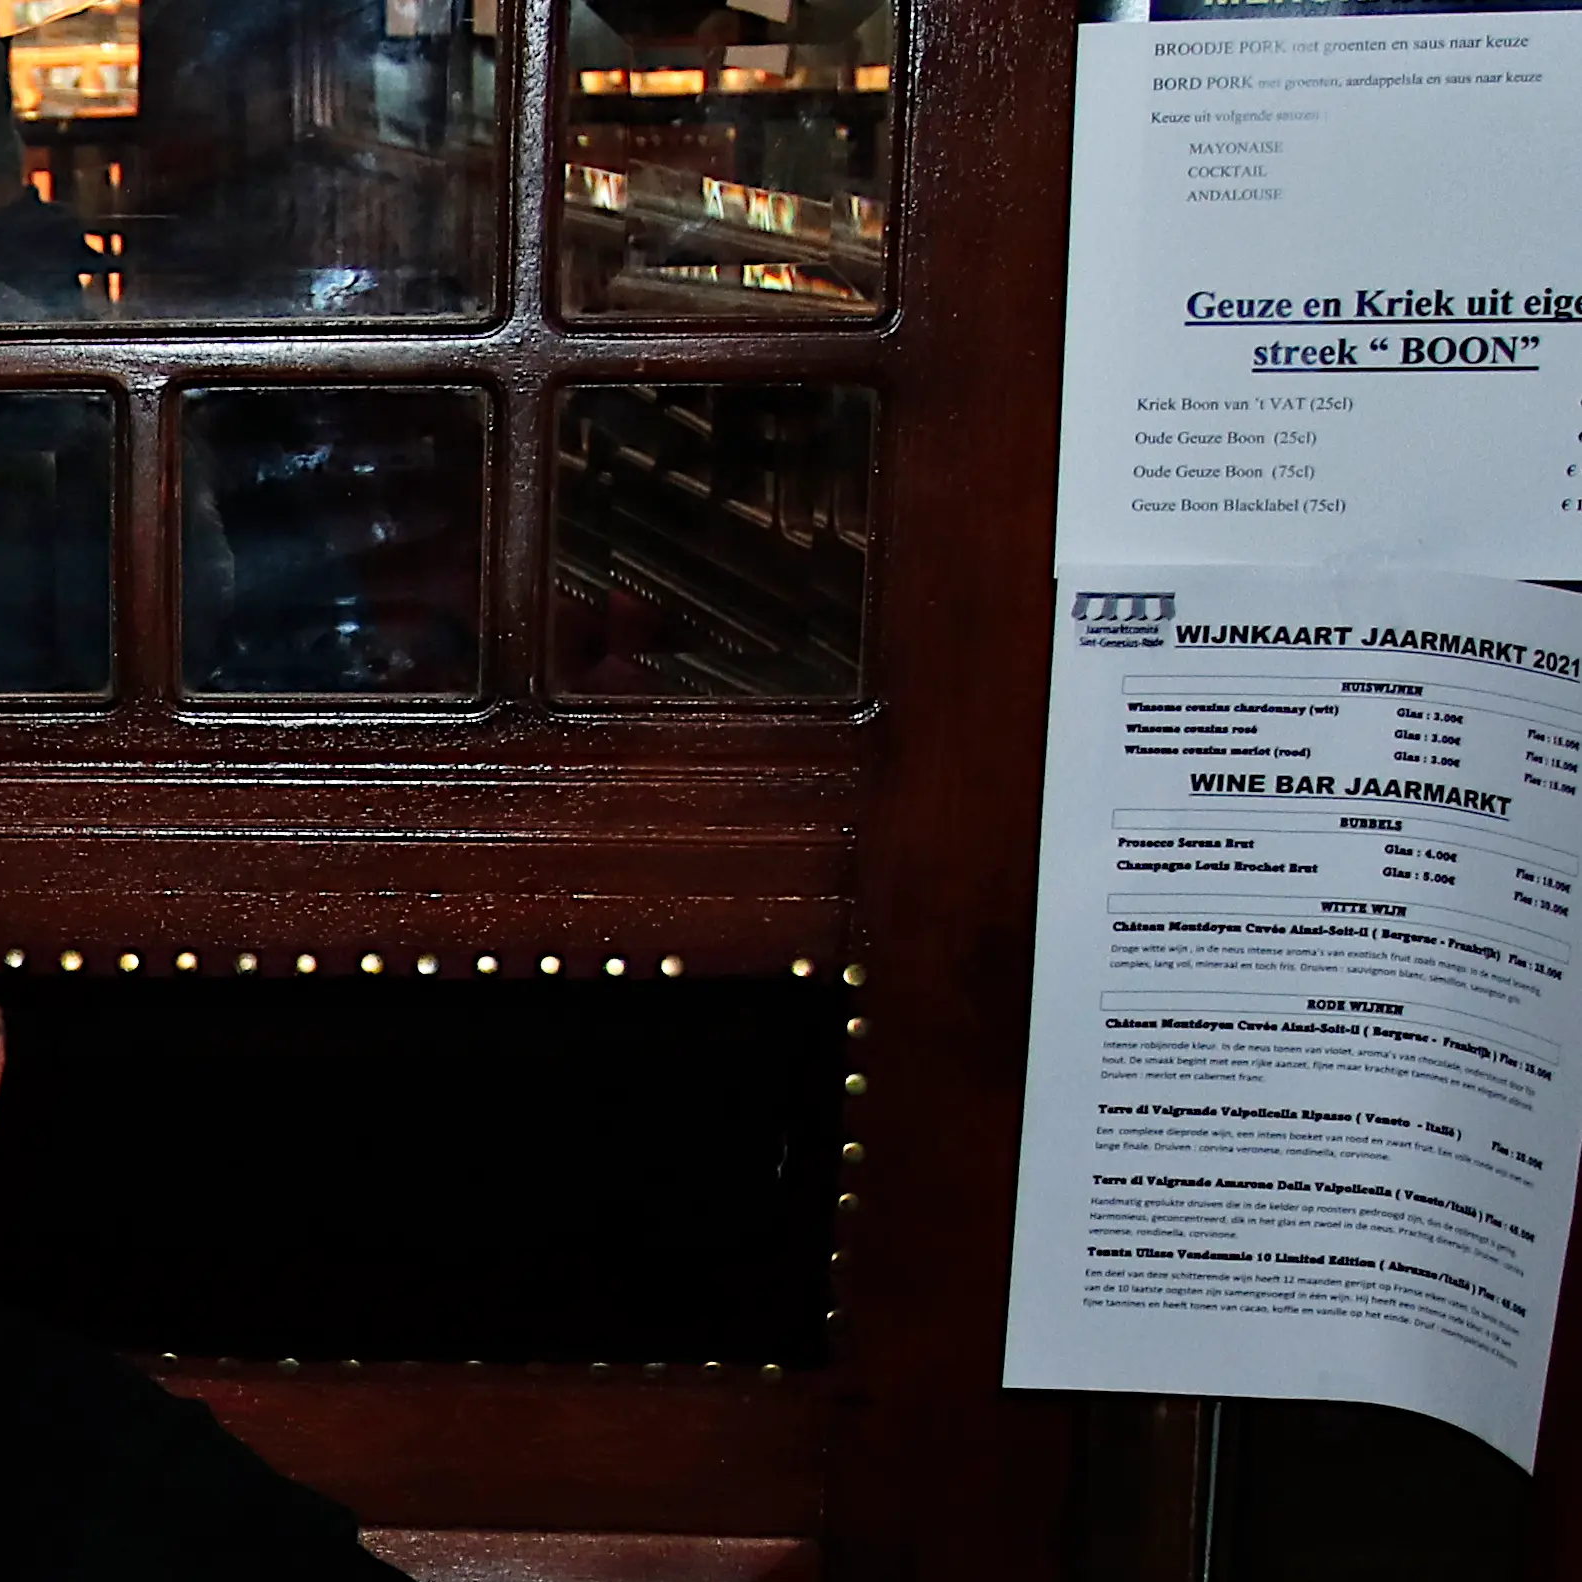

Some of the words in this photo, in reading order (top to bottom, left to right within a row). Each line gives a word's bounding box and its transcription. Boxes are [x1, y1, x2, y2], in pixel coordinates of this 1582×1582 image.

[1154, 42, 1233, 58] BROODJE
[1240, 40, 1287, 55] PORK
[1324, 38, 1388, 57] groenten
[1392, 40, 1409, 51] en
[1413, 38, 1445, 50] saus
[1450, 36, 1482, 49] naar
[1486, 34, 1530, 48] keuze
[1153, 77, 1203, 92] BORD
[1207, 75, 1253, 90] PORK
[1476, 72, 1502, 84] naar
[1506, 69, 1543, 84] keuze
[1151, 111, 1190, 124] Keuze
[1194, 110, 1211, 123] uit
[1189, 141, 1284, 155] MAYONAISE
[1187, 165, 1268, 179] COCKTAIL
[1186, 188, 1283, 202] ANDALOUSE
[1186, 290, 1293, 319] Geuze
[1304, 297, 1342, 318] en
[1355, 288, 1456, 318] Kriek
[1465, 288, 1513, 317] uit
[1253, 338, 1358, 366] streek
[1136, 397, 1176, 411] Kriek
[1181, 397, 1219, 411] Boon
[1224, 400, 1249, 411] van
[1270, 397, 1306, 411] VAT
[1135, 430, 1173, 445] Oude
[1177, 430, 1222, 445] Geuze
[1227, 430, 1265, 445] Boon
[1133, 464, 1172, 479] Oude
[1175, 464, 1221, 479] Geuze
[1225, 464, 1263, 479] Boon
[1131, 498, 1176, 512] Geuze
[1180, 498, 1218, 512] Boon
[1223, 497, 1298, 512] Blacklabel
[1175, 625, 1353, 646] WIJNKAART
[1361, 626, 1528, 665] JAARMARKT
[1532, 648, 1581, 679] 2021
[1189, 773, 1267, 793] WINE
[1275, 775, 1336, 795] BAR
[1344, 777, 1513, 816] JAARMARKT
[1339, 816, 1403, 832] BUBBELS
[1306, 999, 1346, 1012] RODE
